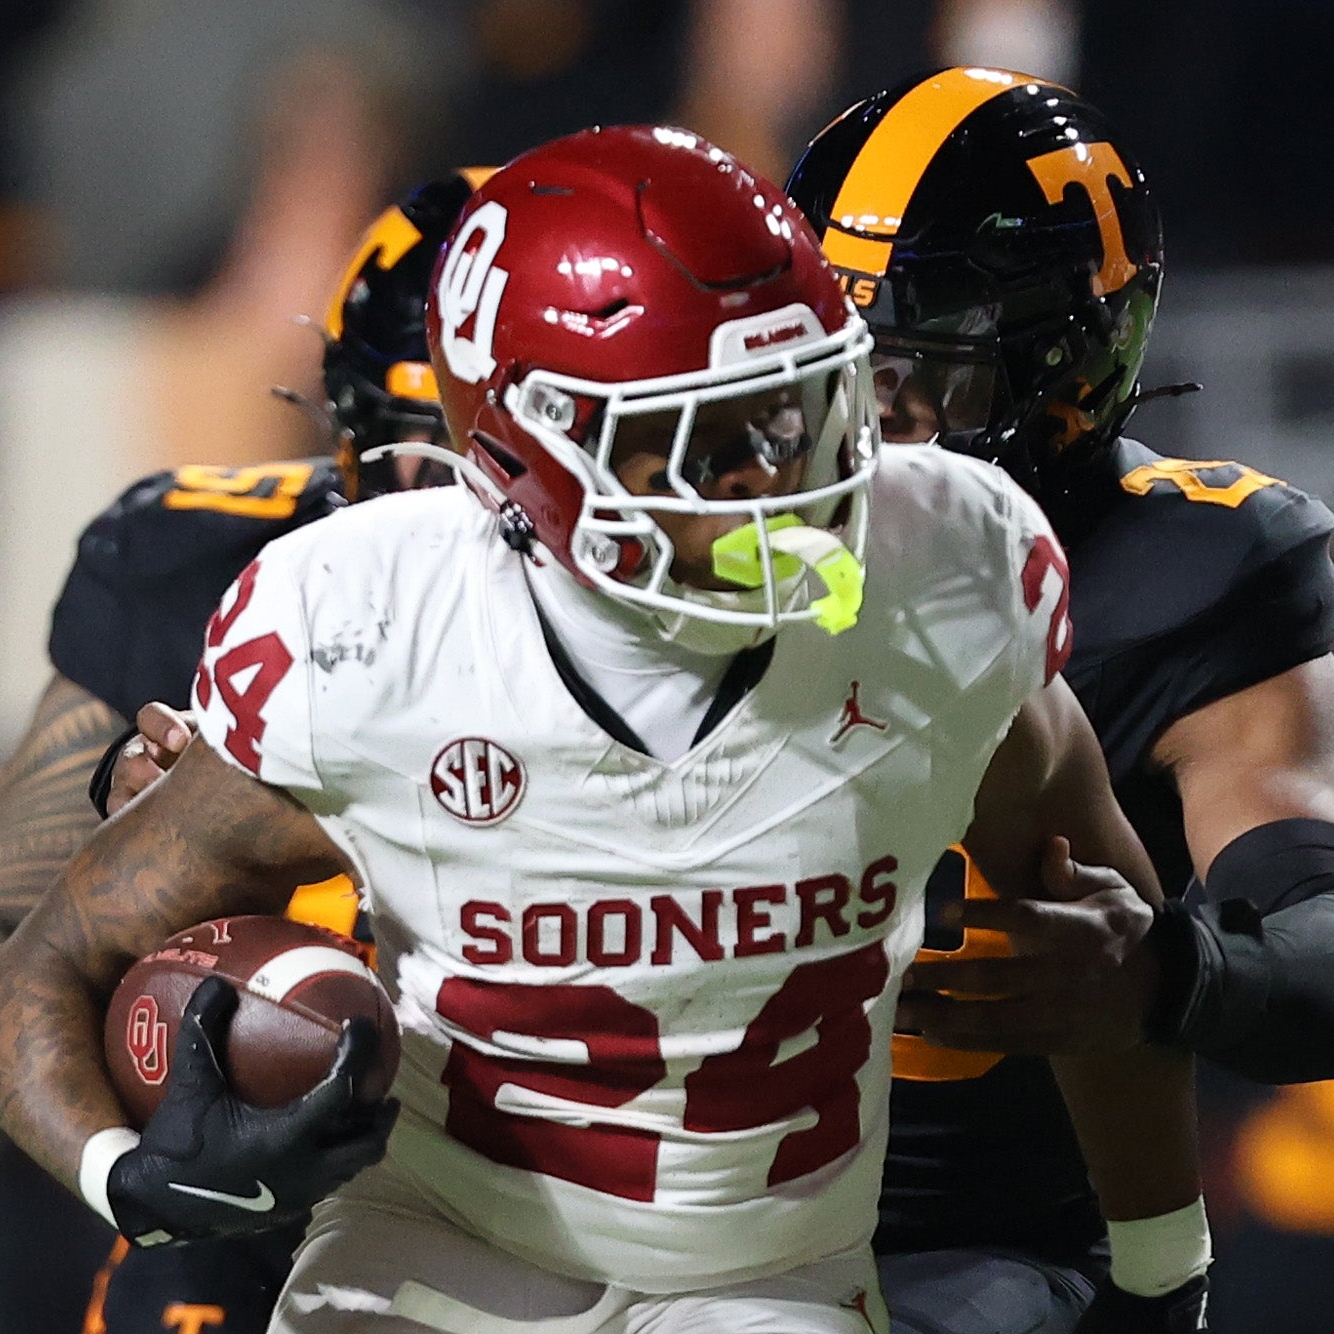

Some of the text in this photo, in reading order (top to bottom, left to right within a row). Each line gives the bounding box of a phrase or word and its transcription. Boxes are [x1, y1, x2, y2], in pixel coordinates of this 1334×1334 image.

[1026, 141, 1133, 297] T
[438, 200, 509, 384] OU
[433, 740, 518, 821] SEC
[458, 855, 899, 967] SOONERS
[127, 995, 168, 1086] OU
[435, 939, 890, 1203] 24
